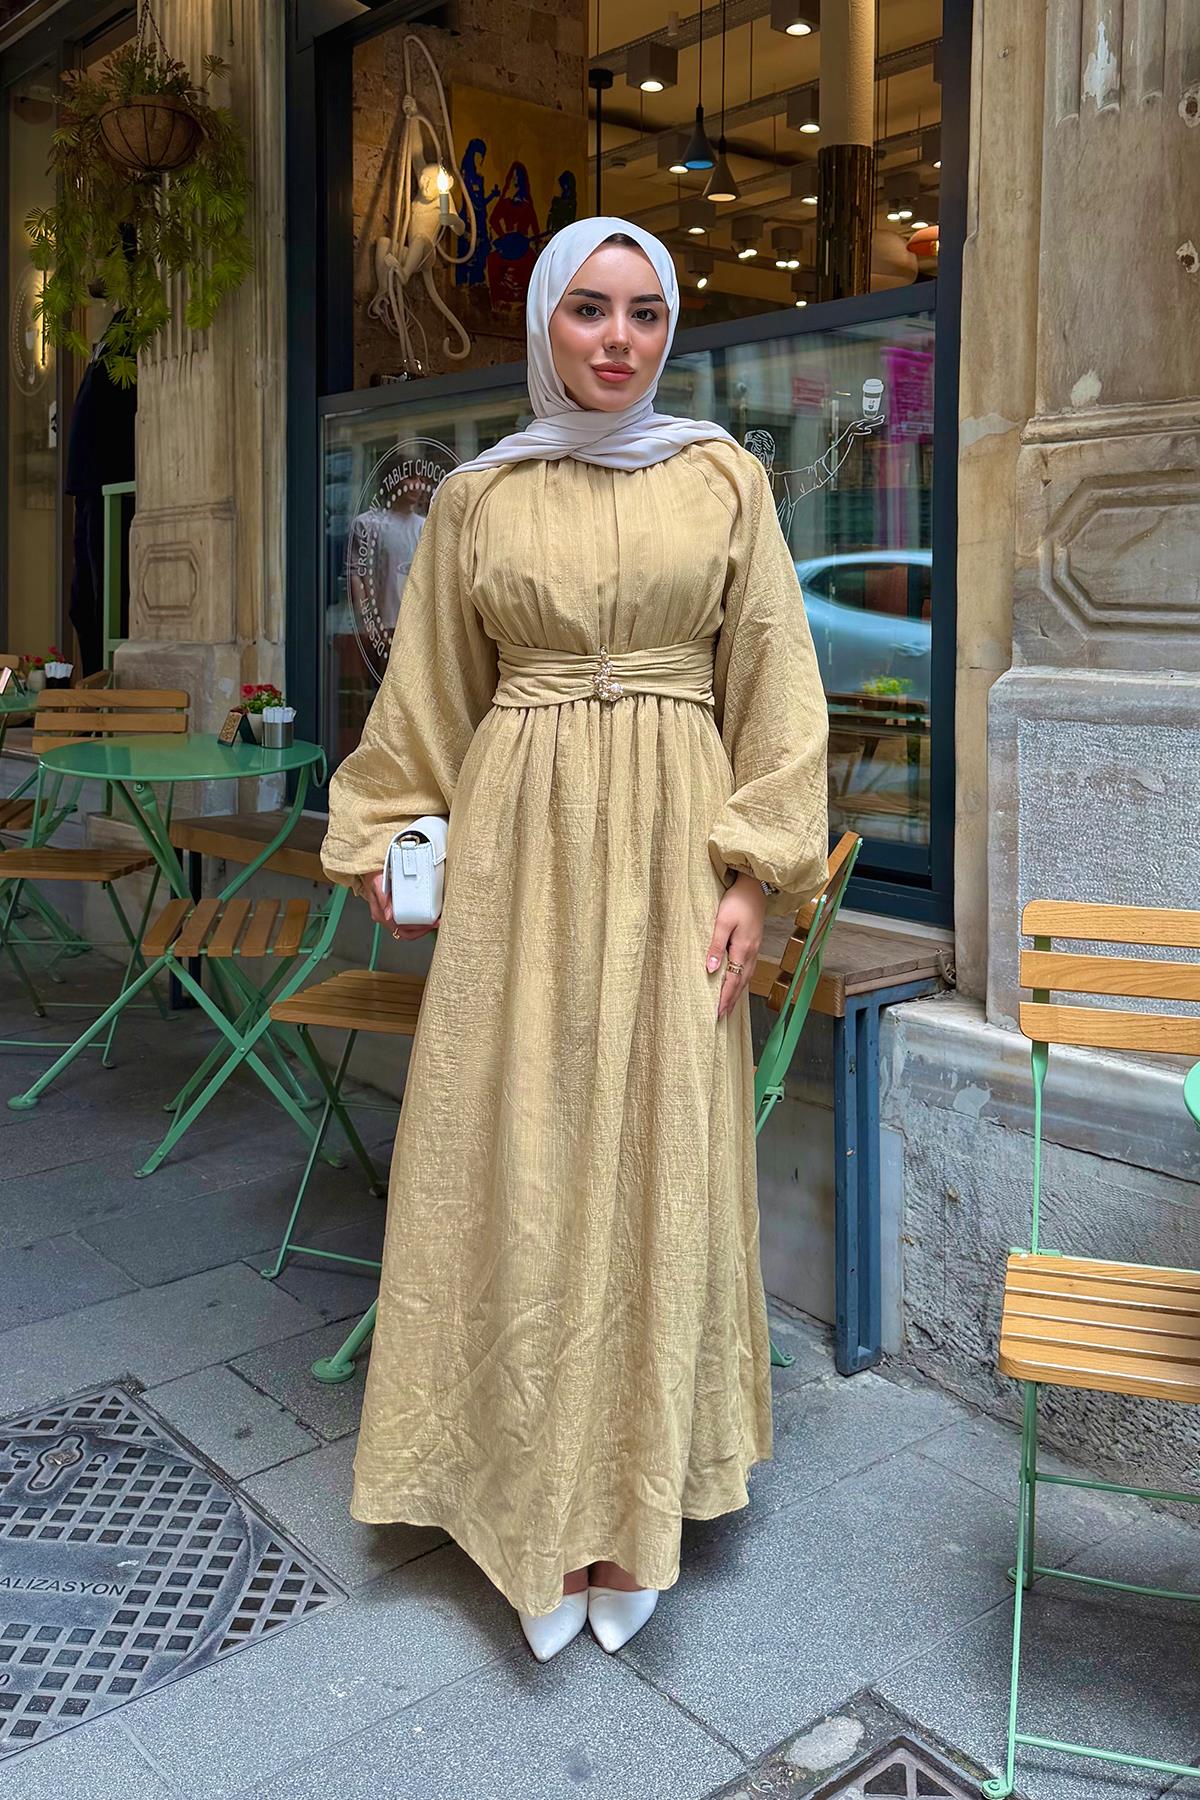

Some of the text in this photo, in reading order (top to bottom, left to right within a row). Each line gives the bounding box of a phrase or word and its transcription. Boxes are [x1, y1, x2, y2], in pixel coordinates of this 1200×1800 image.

[382, 460, 413, 492] TABLET
[357, 493, 381, 577] CROISNT
[360, 598, 386, 657] DESSERT
